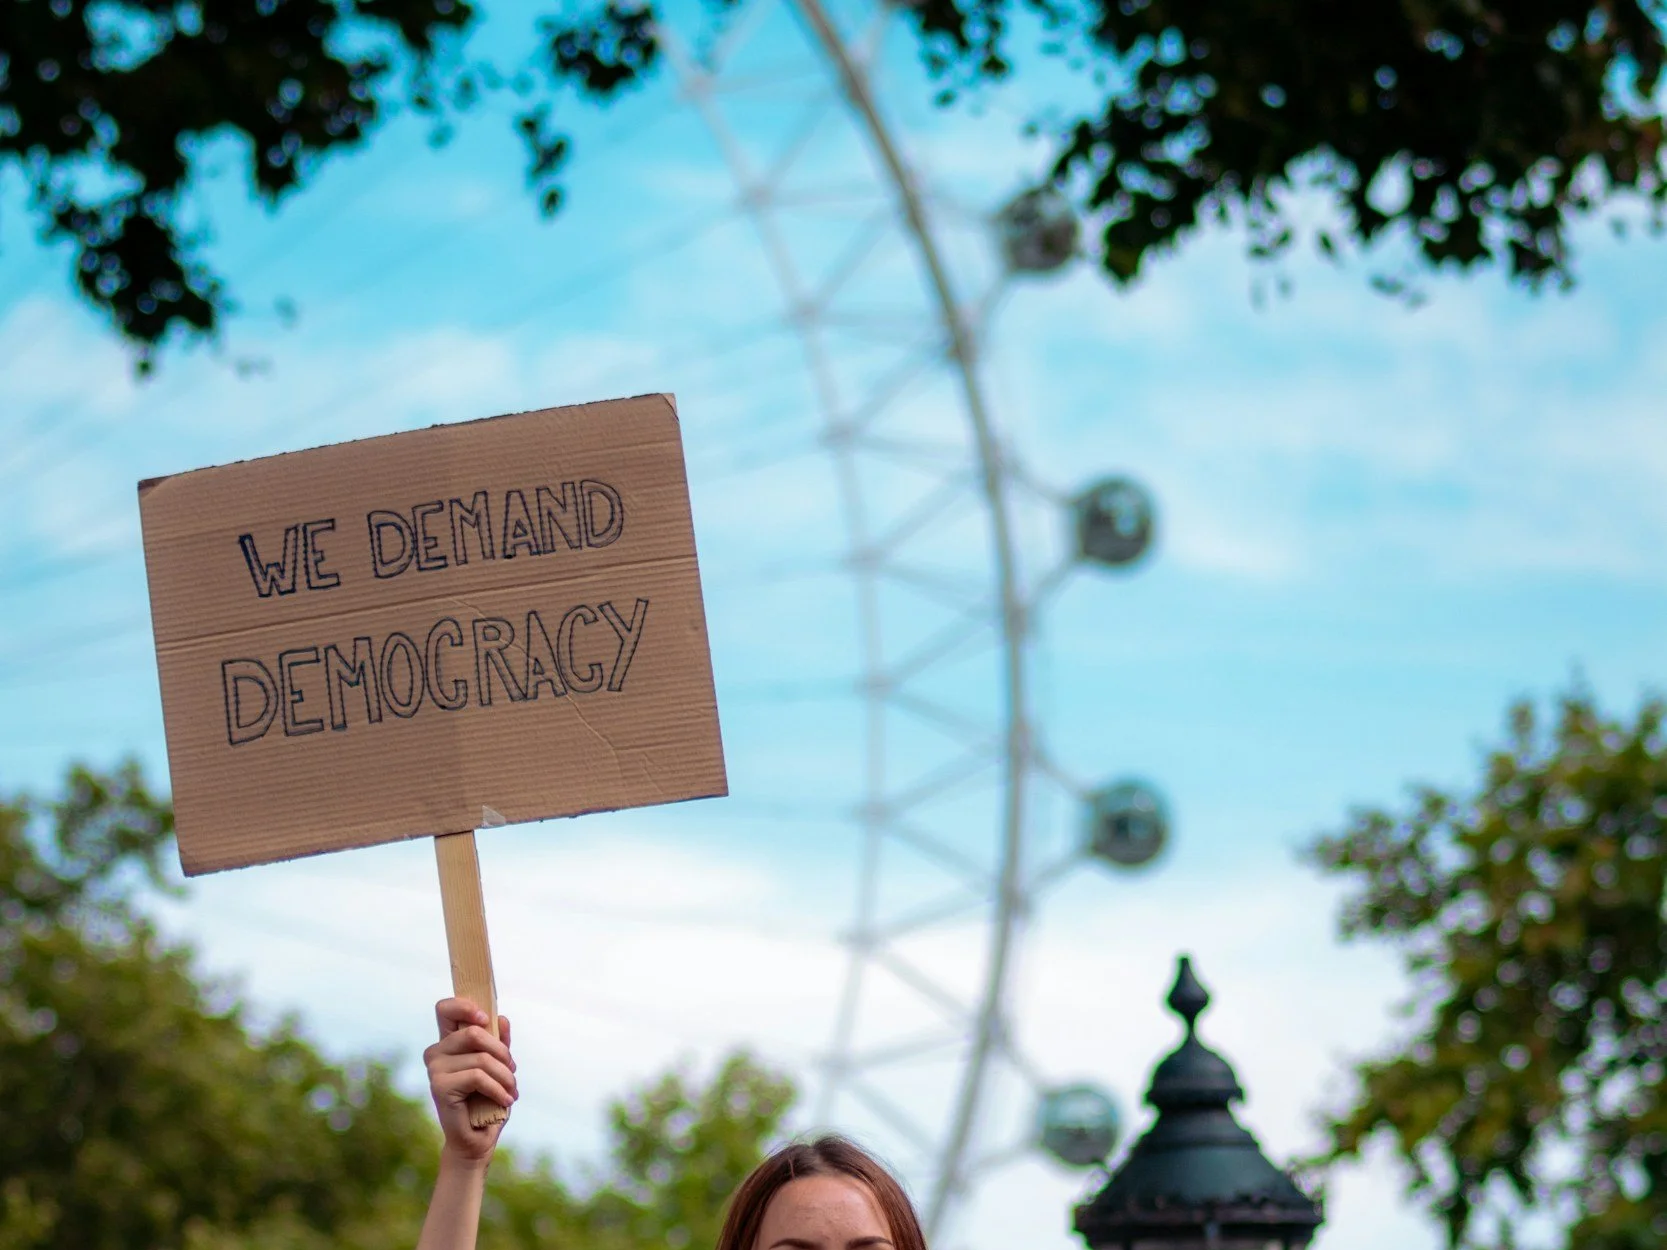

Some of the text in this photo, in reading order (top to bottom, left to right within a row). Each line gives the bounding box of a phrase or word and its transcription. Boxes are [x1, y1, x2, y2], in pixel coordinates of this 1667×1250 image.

[239, 479, 625, 598] WE DEMAND
[221, 598, 650, 746] DEMOCRACY
